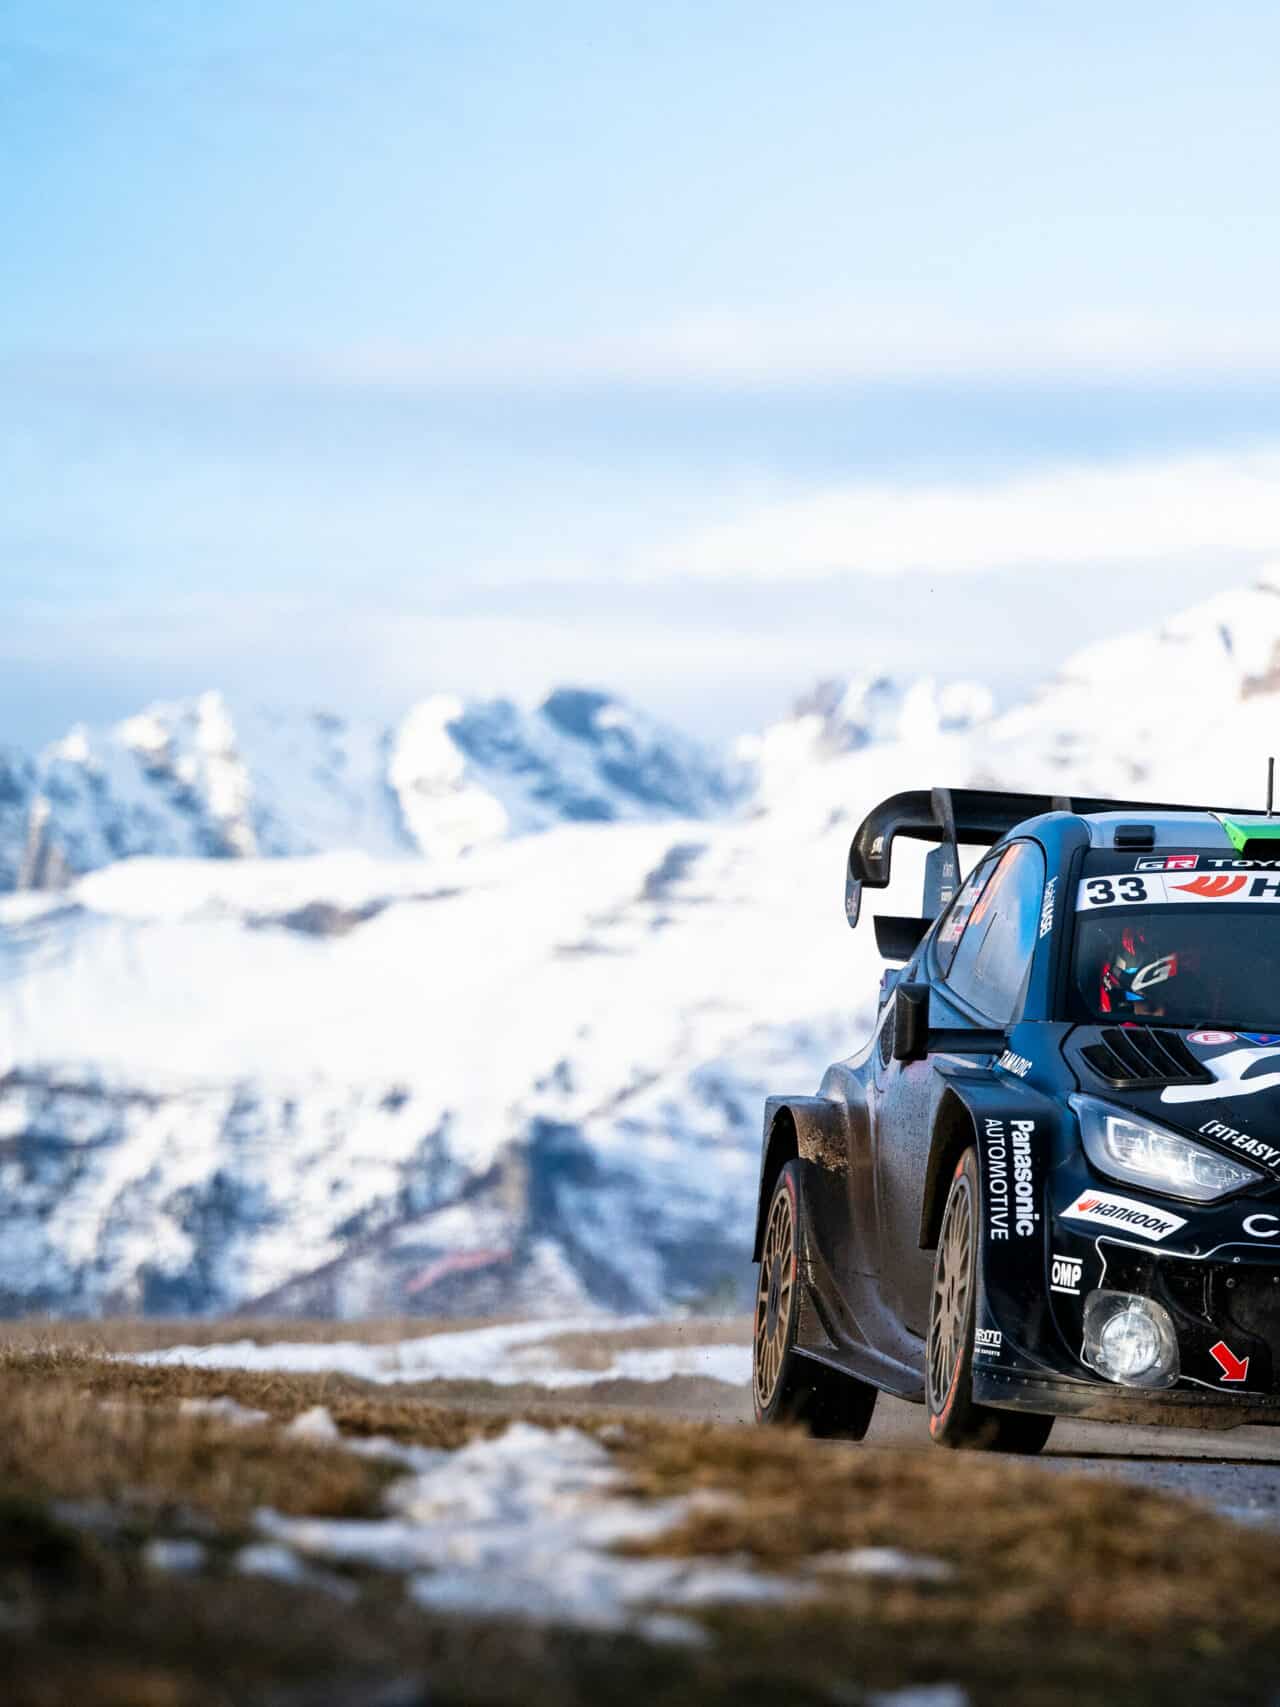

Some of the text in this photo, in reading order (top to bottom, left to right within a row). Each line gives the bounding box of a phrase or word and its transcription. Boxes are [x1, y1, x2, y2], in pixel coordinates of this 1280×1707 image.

[1136, 857, 1196, 871] GR
[1086, 876, 1148, 905] 33
[983, 1118, 1010, 1241] AUTOMOTIVE
[1010, 1119, 1041, 1238] Panasonic
[1051, 1259, 1083, 1289] OMP
